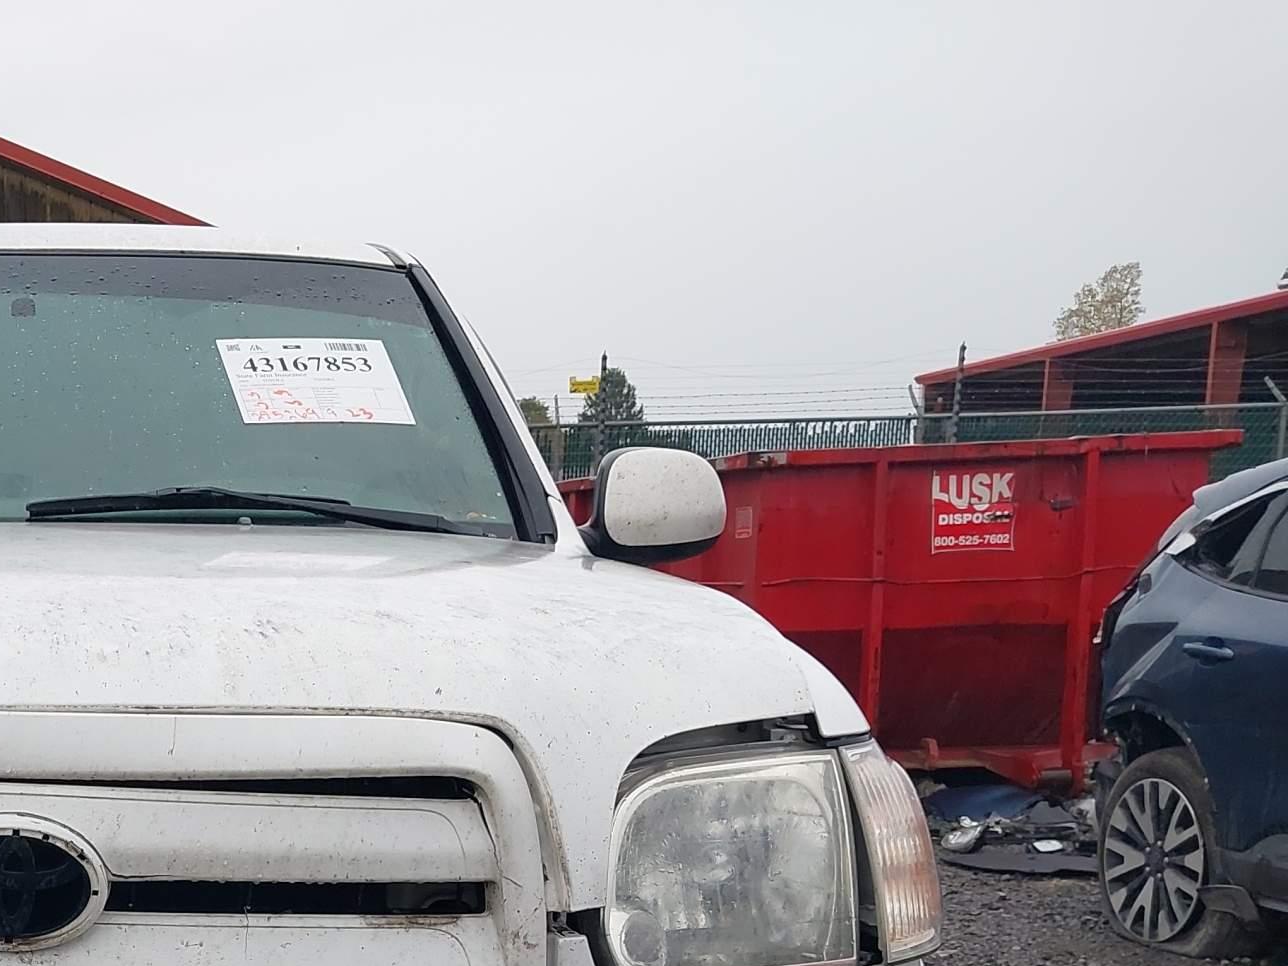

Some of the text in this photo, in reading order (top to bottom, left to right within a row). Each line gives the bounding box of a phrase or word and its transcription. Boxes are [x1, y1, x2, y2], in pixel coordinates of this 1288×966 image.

[243, 357, 373, 373] 43167853
[932, 472, 1015, 511] LUSK
[934, 533, 1010, 547] 800-525-7602
